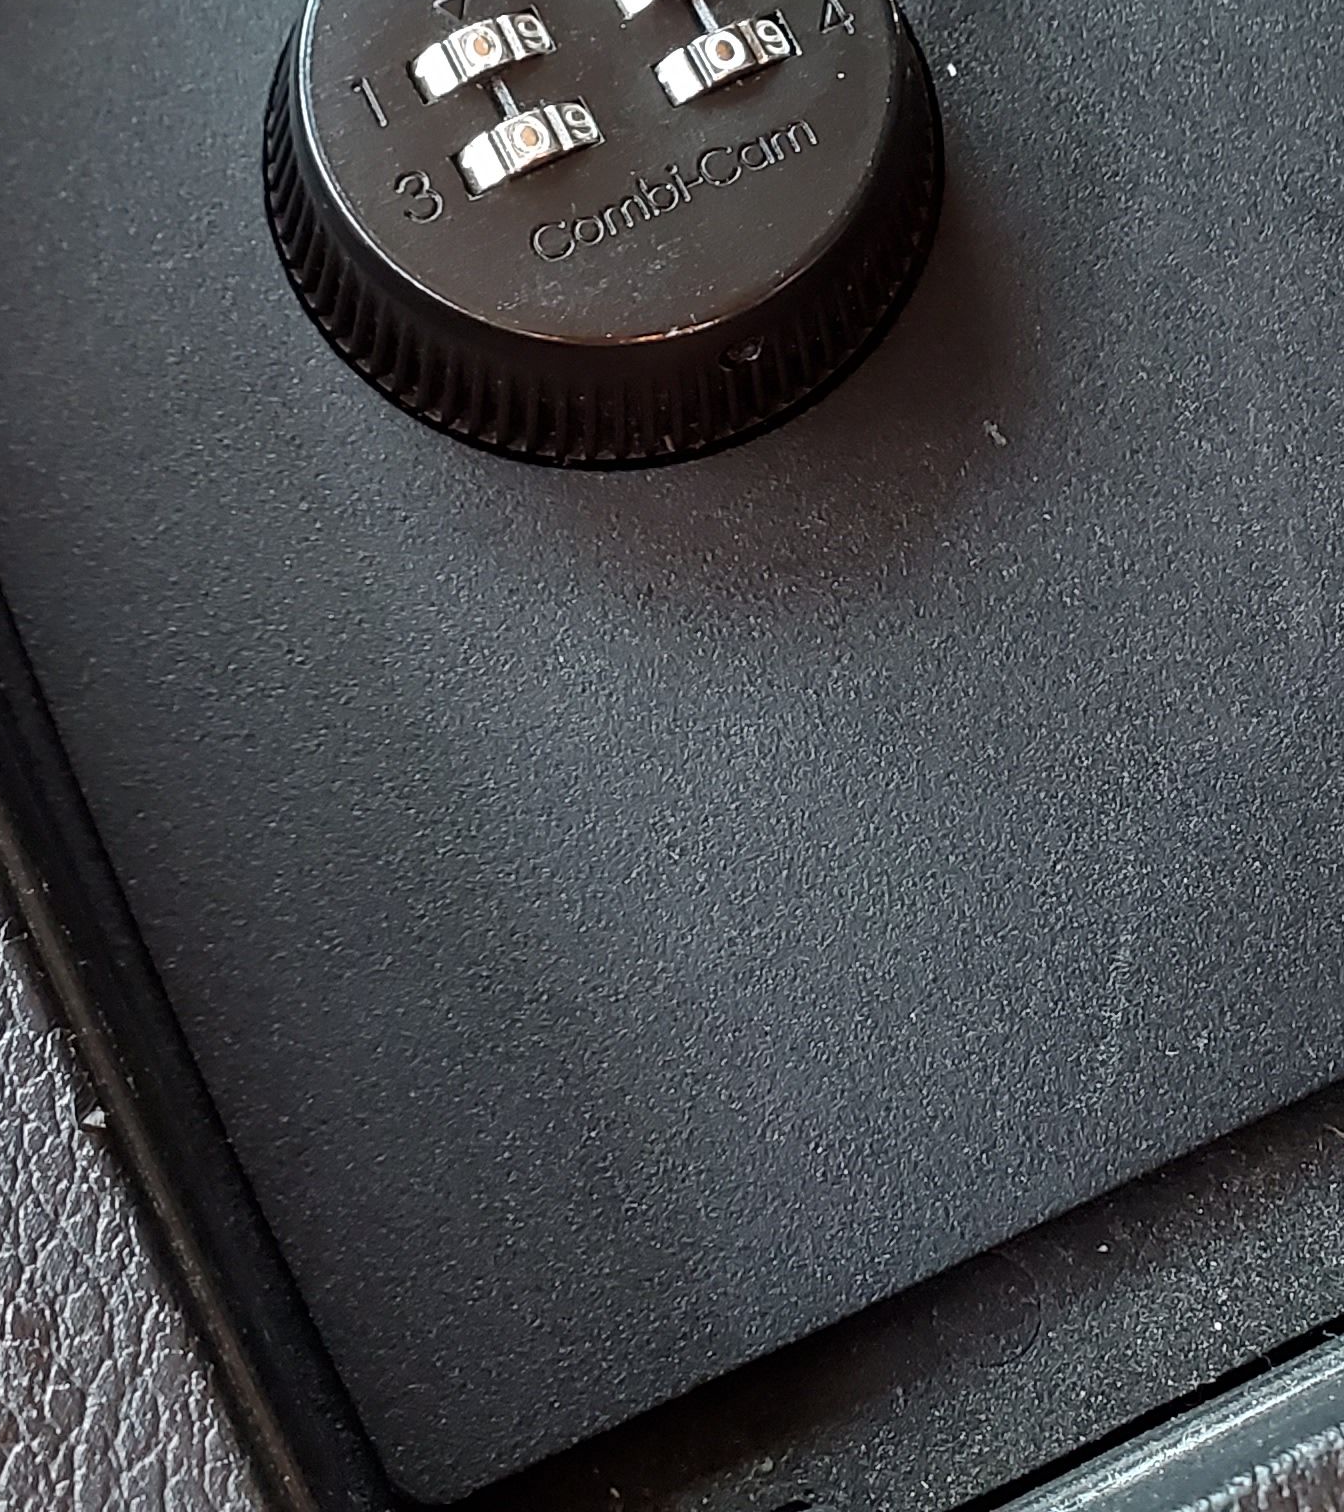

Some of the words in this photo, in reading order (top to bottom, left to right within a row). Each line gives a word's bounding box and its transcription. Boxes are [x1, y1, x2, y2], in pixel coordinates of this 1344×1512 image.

[352, 75, 389, 128] 1
[393, 169, 445, 225] 3
[530, 119, 819, 263] Combi-Cam
